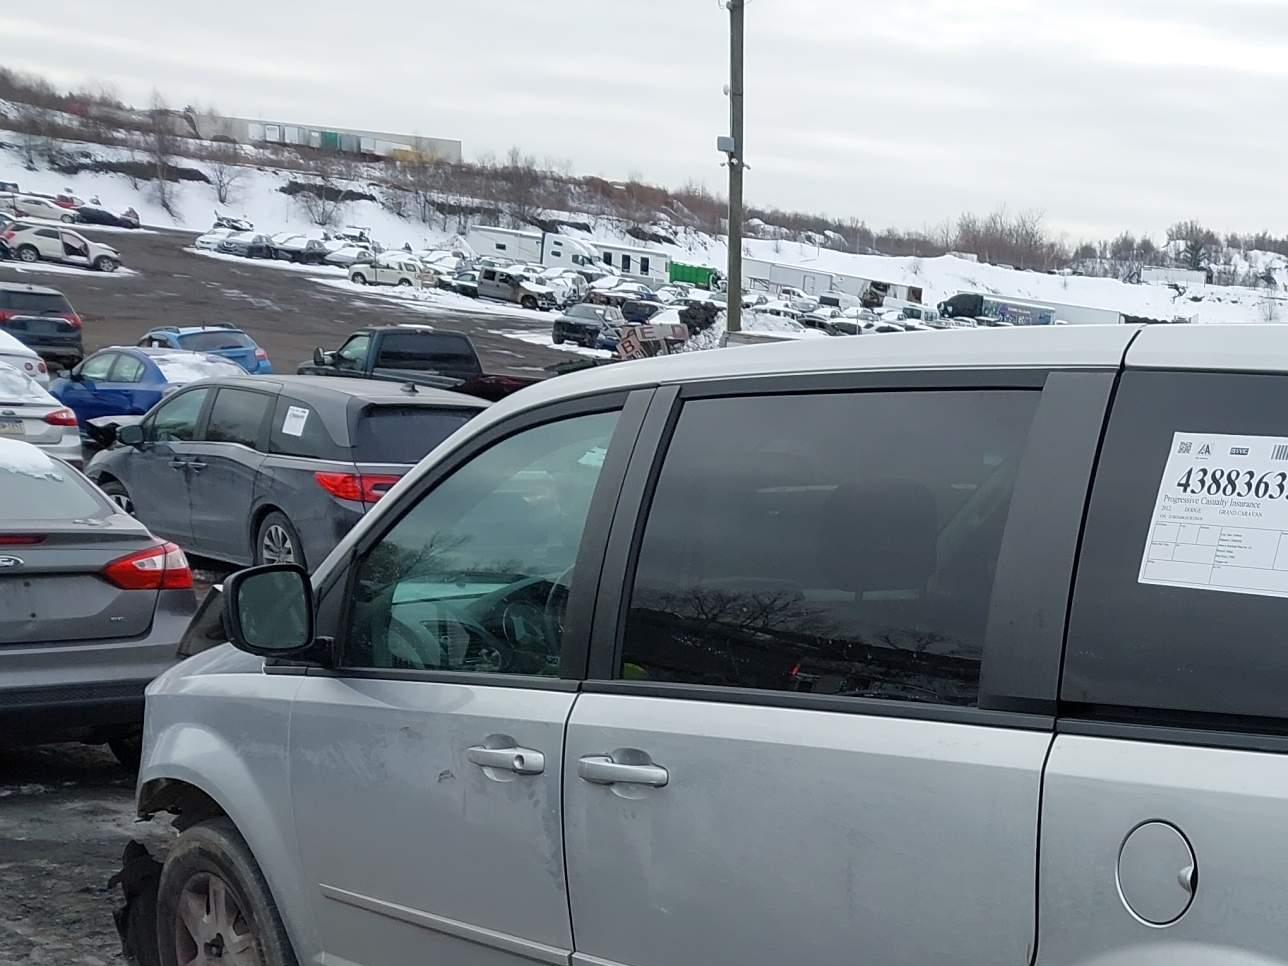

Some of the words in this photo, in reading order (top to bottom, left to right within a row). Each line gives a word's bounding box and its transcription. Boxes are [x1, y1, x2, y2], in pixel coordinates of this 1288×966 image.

[1163, 494, 1199, 505] Progressive
[1200, 497, 1228, 508] Casualty
[1229, 499, 1262, 509] Insurance
